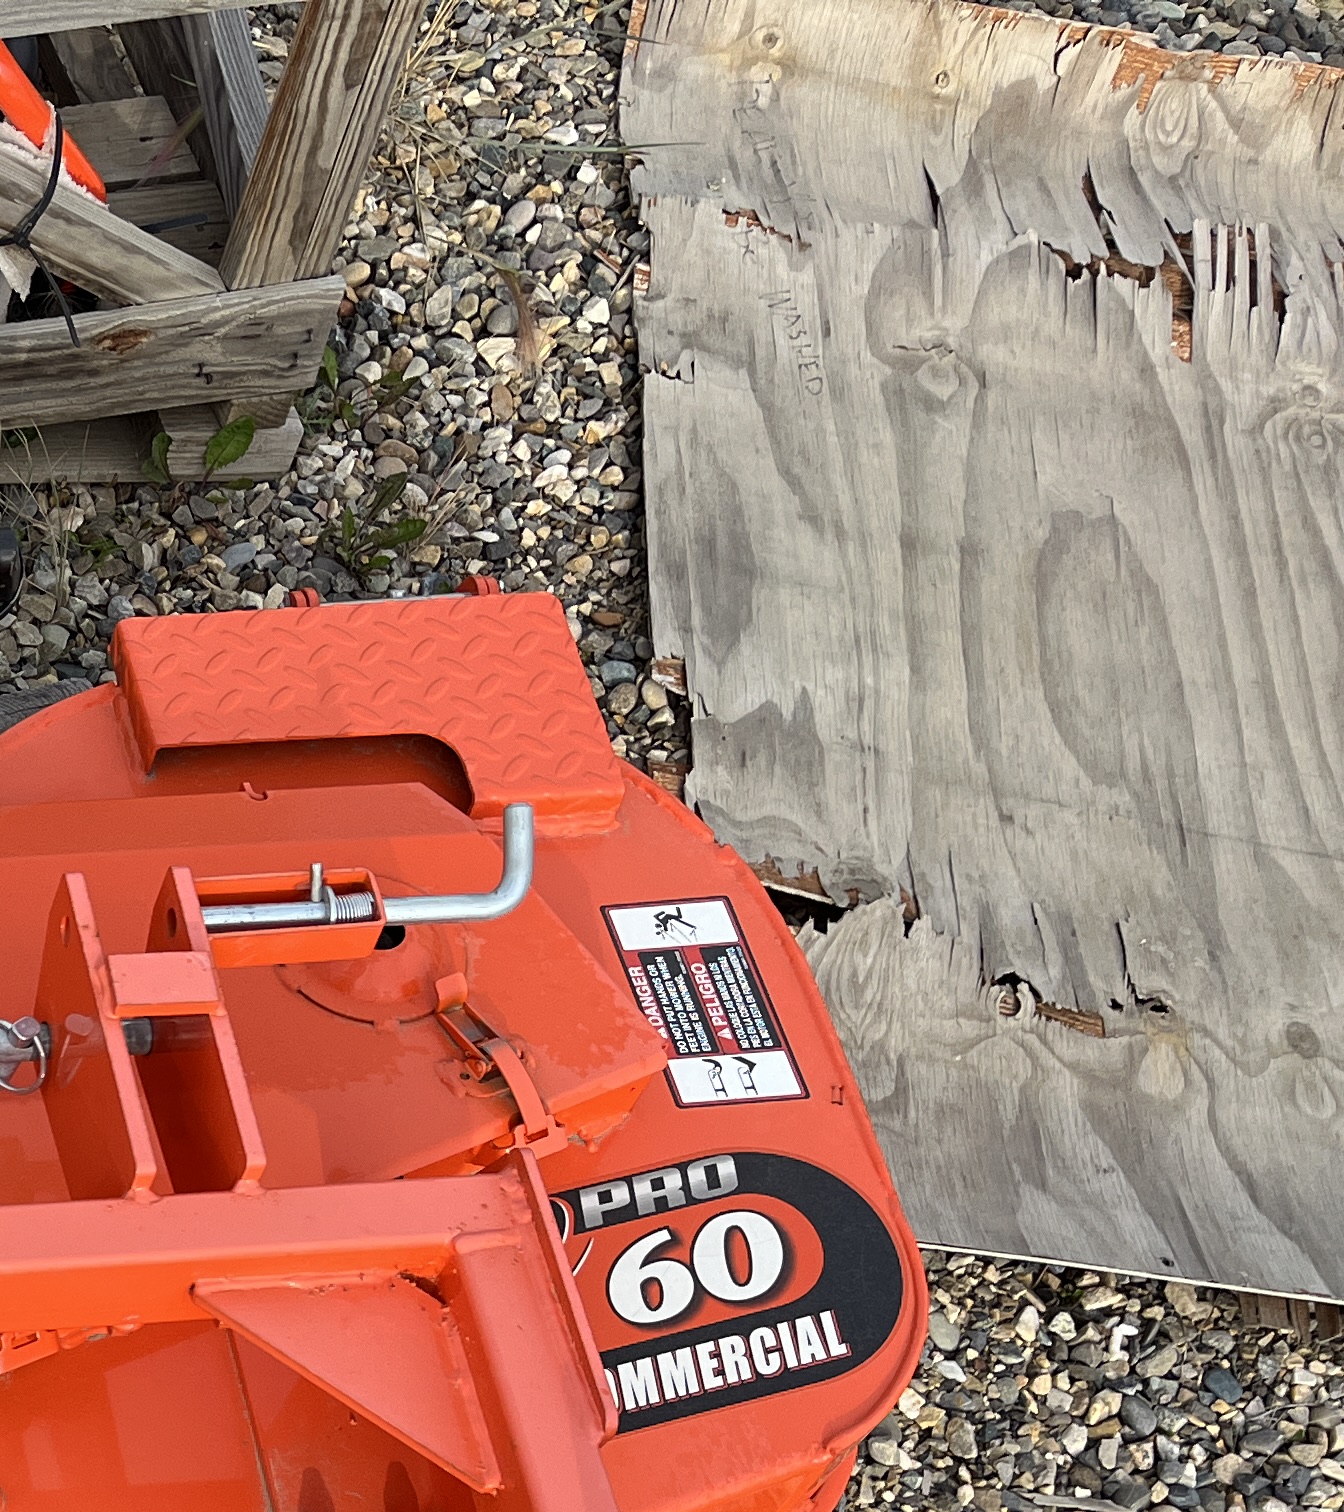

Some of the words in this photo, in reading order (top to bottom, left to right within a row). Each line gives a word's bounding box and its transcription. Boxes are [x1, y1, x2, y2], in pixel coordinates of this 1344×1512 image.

[645, 963, 660, 976] OR
[654, 955, 672, 979] WHEN
[627, 965, 664, 1027] DANGER
[651, 976, 671, 1005] HANDS
[664, 980, 685, 1011] MOWER
[672, 973, 696, 1011] RUNNING.
[688, 961, 728, 1026] PELIGRO
[662, 1005, 677, 1022] PUT
[676, 1011, 693, 1031] INTO
[688, 1011, 700, 1020] IS
[668, 1022, 684, 1039] NOT
[684, 1031, 701, 1052] FEET
[691, 1020, 712, 1052] ENGINE
[675, 1040, 690, 1053] DO
[578, 1154, 740, 1229] PRO
[605, 1209, 785, 1325] 60
[604, 1309, 852, 1415] MMERCIAL
